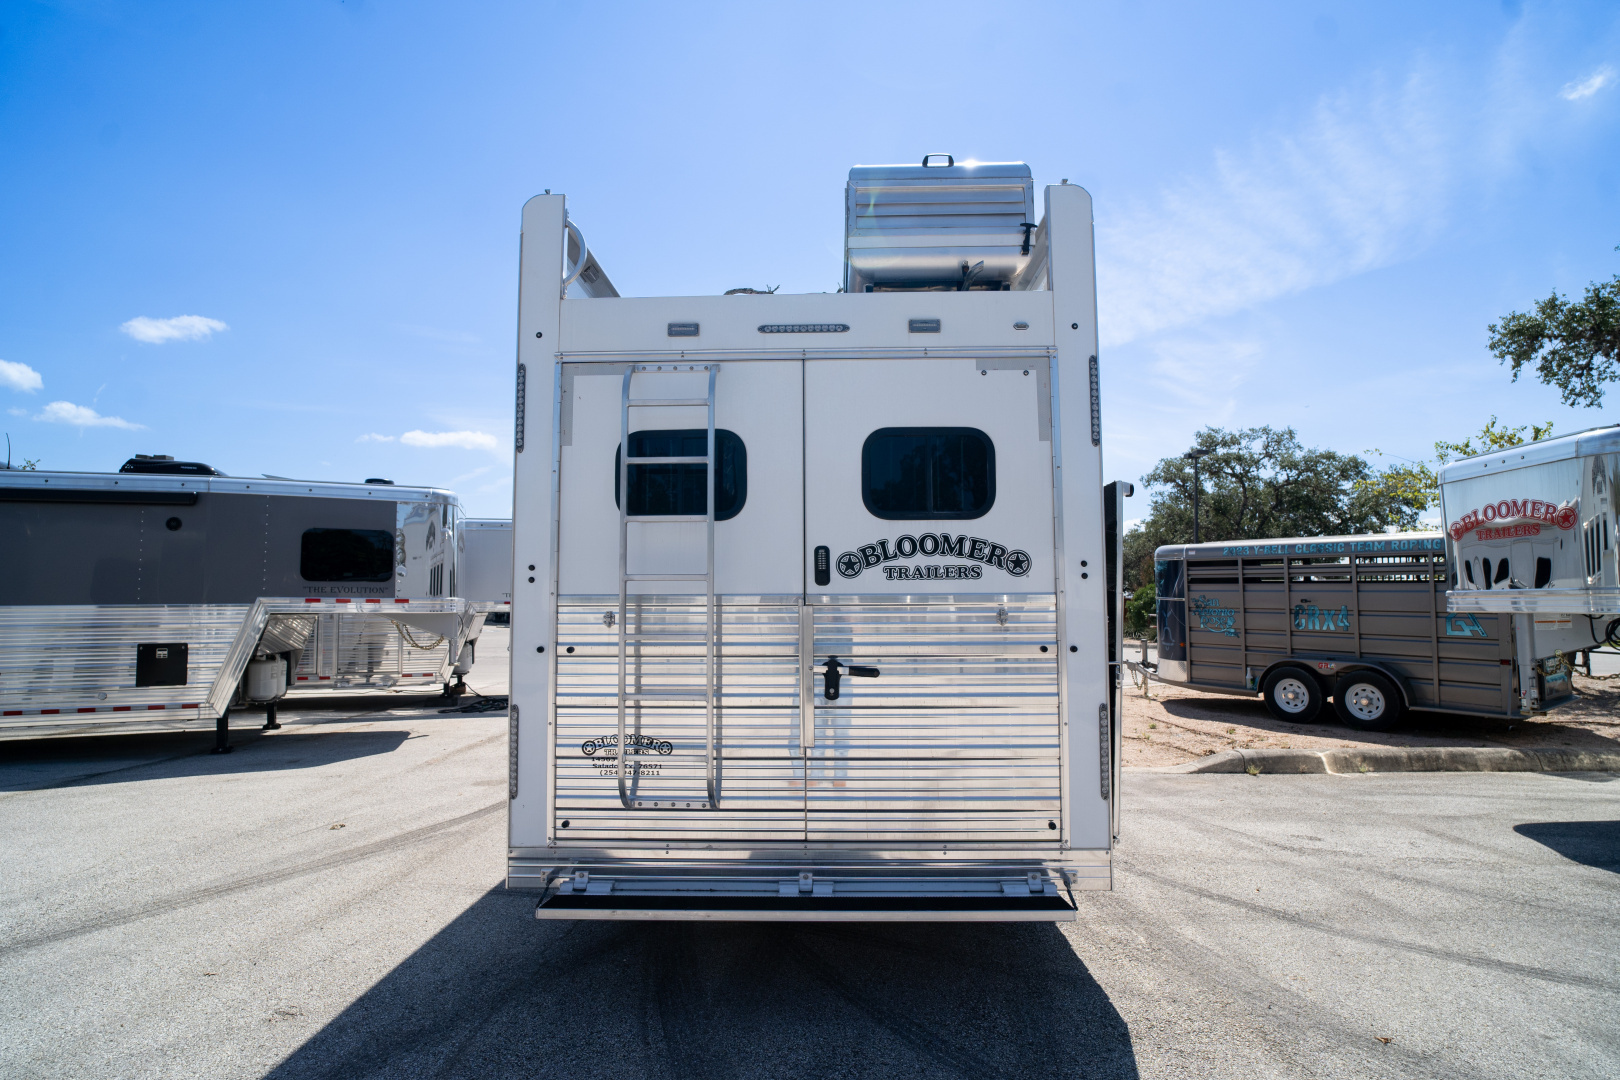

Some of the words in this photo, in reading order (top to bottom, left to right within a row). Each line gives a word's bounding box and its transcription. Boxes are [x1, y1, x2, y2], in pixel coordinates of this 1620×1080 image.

[1460, 498, 1558, 534] BLOOMER
[1476, 523, 1541, 541] TRAILERS
[857, 532, 1009, 570] BLOOMER
[1295, 542, 1345, 554] CLASSIC
[1350, 541, 1385, 552] TEAM
[1391, 539, 1442, 551] ROPING
[883, 565, 983, 580] TRAILERS
[1199, 594, 1220, 607] San
